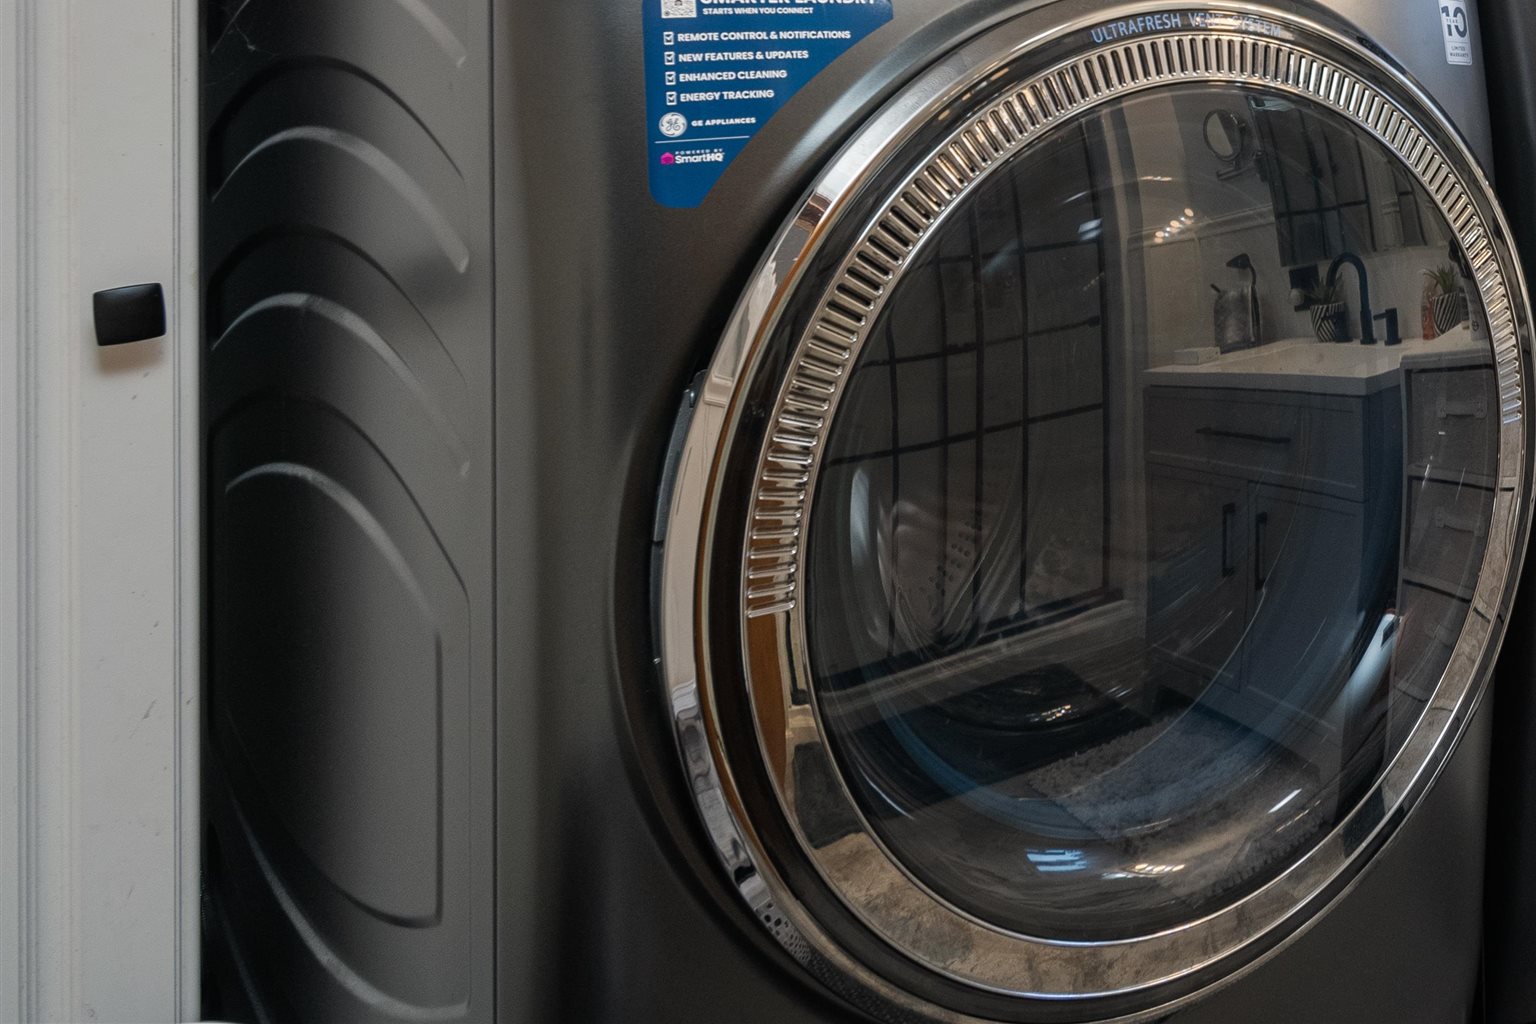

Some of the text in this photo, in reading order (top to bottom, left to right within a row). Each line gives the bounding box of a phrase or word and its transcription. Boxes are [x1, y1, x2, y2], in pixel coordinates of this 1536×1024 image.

[702, 6, 814, 15] STARTS WHEN YOU CONNECT
[1441, 5, 1467, 38] 10
[1090, 12, 1281, 44] ULTRAFRESH VENT SYSTEM
[677, 30, 851, 42] REMOTE CONTROL & NOTIFICATIONS
[678, 50, 809, 62] NEW FEATURES & UPDATES
[679, 69, 788, 82] ENHANCED CLEANING
[680, 89, 775, 102] ENERGY TRACKING
[705, 117, 756, 126] APPLIANCES
[675, 153, 724, 164] SmartHQ
